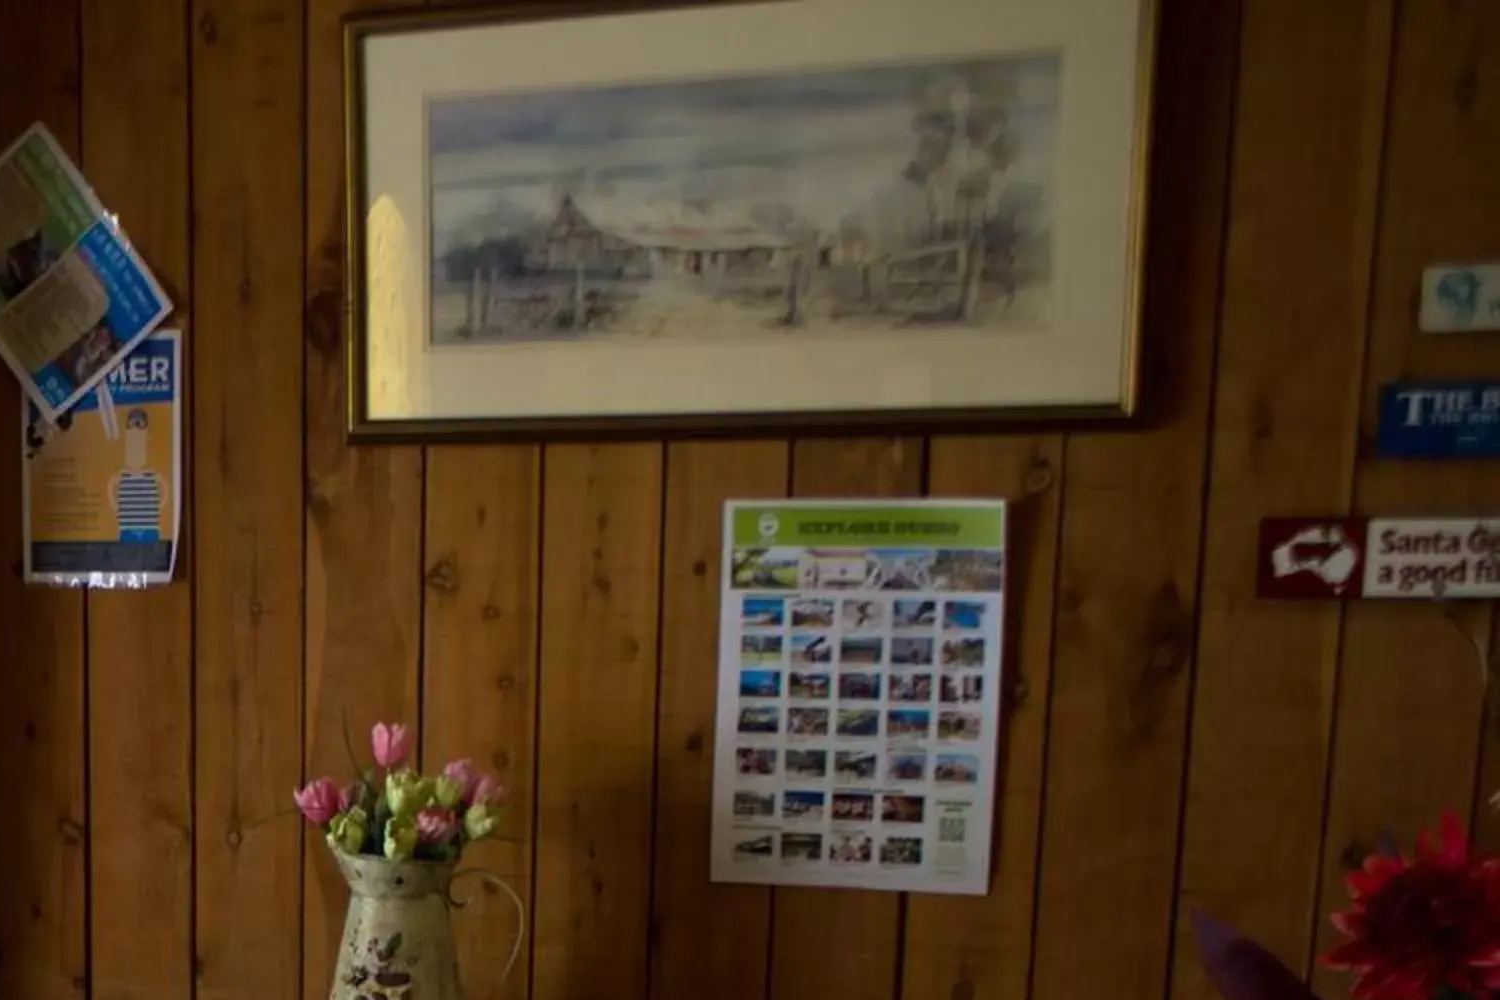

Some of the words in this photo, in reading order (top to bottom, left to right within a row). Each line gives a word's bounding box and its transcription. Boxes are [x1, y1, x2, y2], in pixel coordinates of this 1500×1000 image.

[1380, 529, 1461, 554] Santa
[1377, 563, 1394, 585] a
[1398, 555, 1468, 592] good
